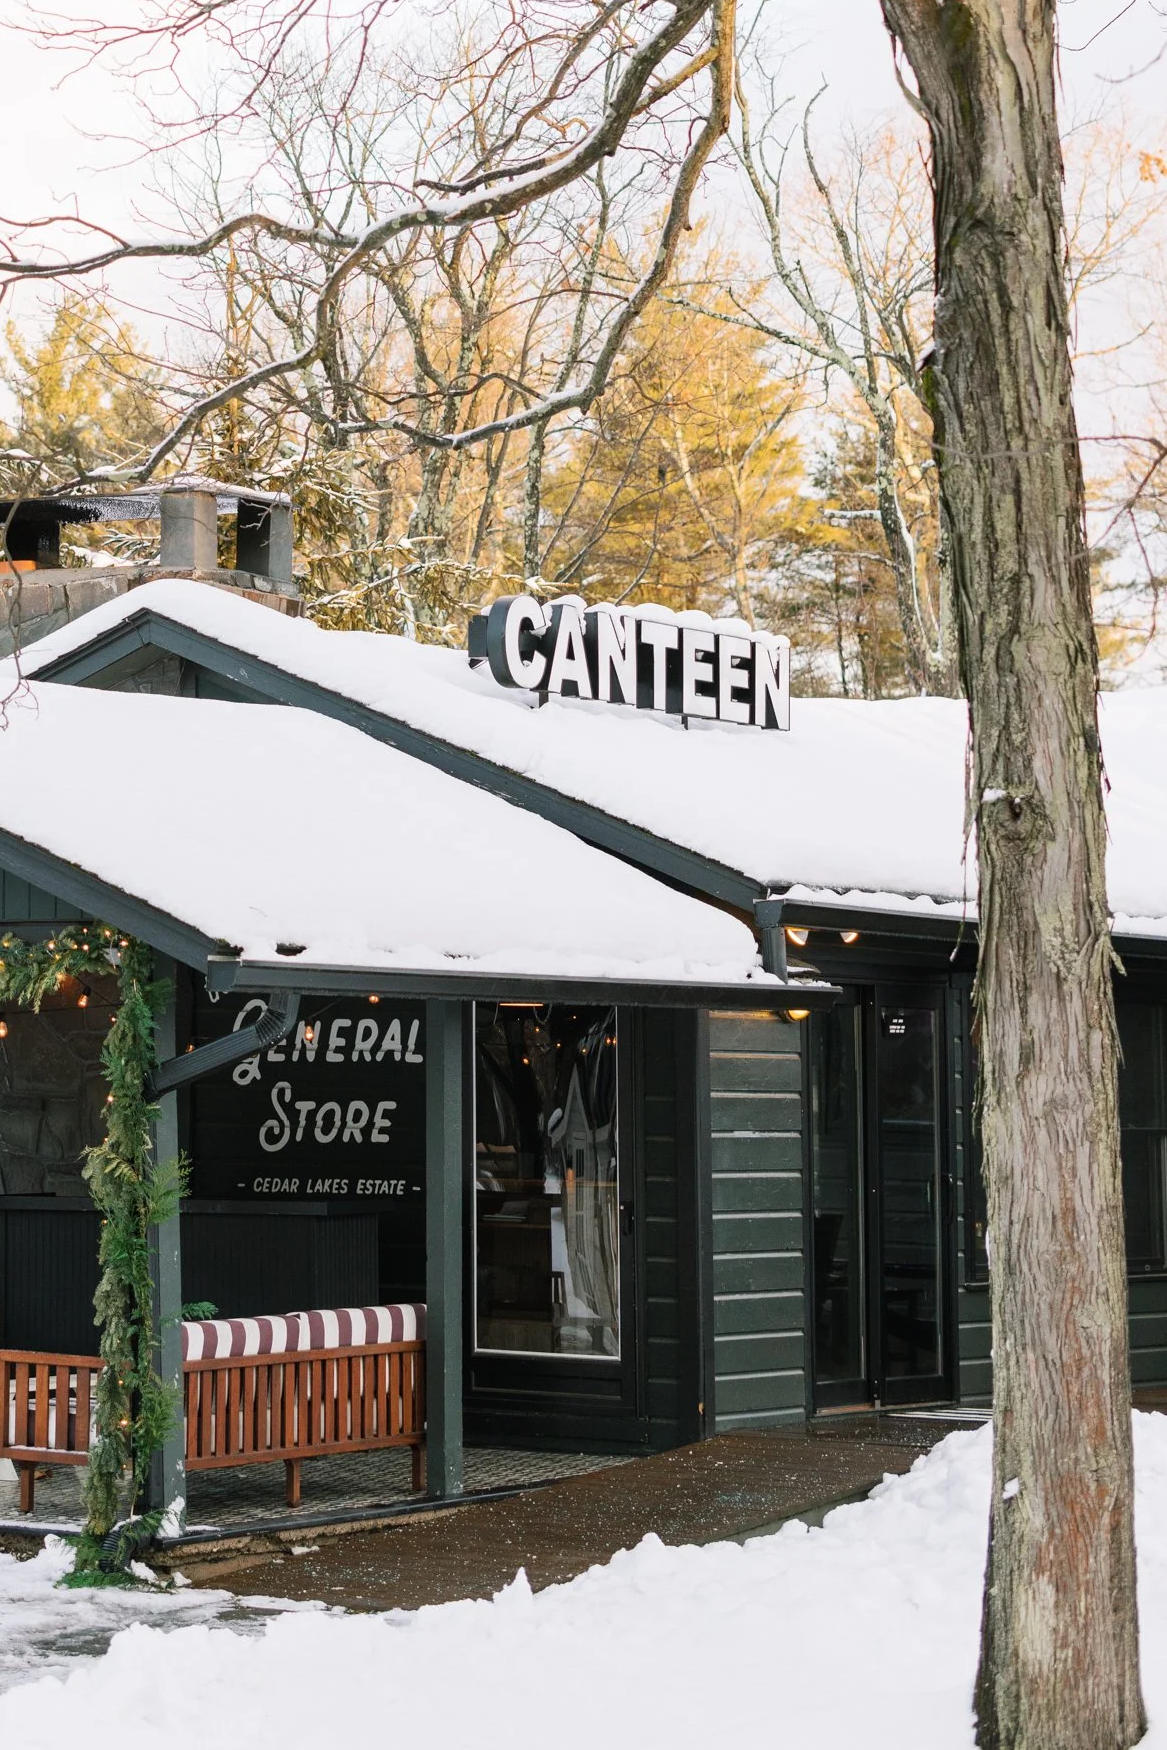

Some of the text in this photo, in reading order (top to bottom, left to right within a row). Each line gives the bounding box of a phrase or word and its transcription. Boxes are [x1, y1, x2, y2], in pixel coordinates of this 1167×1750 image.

[488, 595, 790, 731] CANTEEN
[259, 1081, 397, 1152] STORE
[253, 1177, 406, 1195] CEDAR LAKES ESTATE
